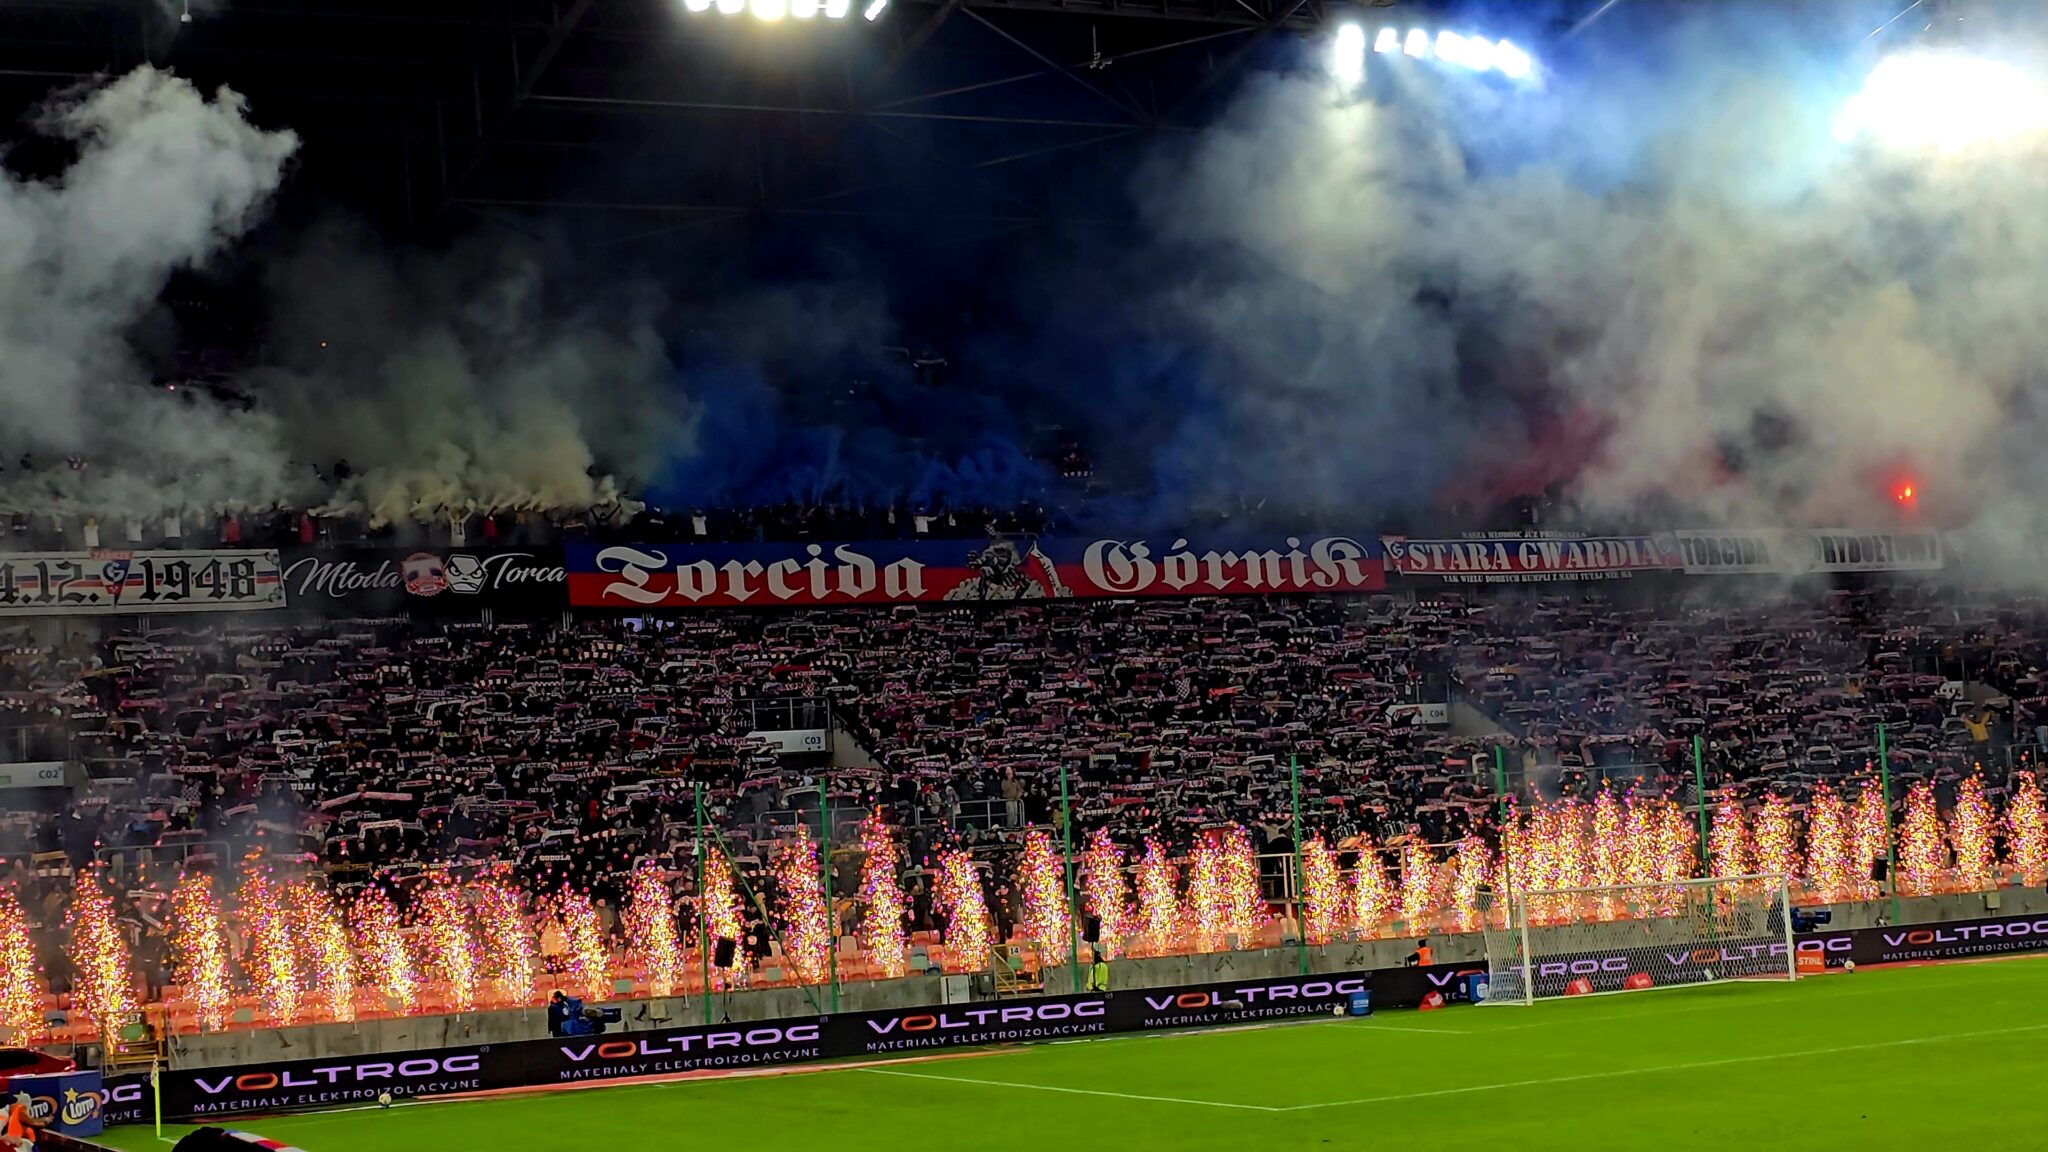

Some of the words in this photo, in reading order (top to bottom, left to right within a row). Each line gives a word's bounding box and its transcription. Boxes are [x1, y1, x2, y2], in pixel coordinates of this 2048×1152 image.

[1408, 542, 1512, 571] STARA
[1518, 539, 1662, 569] GWARDIA
[1680, 537, 1770, 566] TORCIDA
[139, 559, 256, 602] 1948
[283, 557, 402, 598] Młoda
[596, 544, 926, 604] Torcida
[1430, 709, 1444, 718] C04
[804, 736, 821, 745] C03
[38, 769, 59, 779] C02
[1797, 956, 1823, 966] STIHL
[1883, 948, 1940, 961] MATERIAŁY
[1144, 979, 1364, 1011] VOLTROG
[866, 1001, 1105, 1034] VOLTROG
[1144, 1012, 1218, 1028] MATERIAŁY
[560, 1025, 819, 1061] VOLTROG
[866, 1035, 947, 1052] MATERIAŁY
[953, 1022, 1105, 1044] ELEKTROIZOLACYJNE
[194, 1055, 480, 1094] VOLTROG
[560, 1063, 648, 1079] MATERIAŁY
[655, 1047, 820, 1071] ELEKTROIZOLACYJNE
[69, 1098, 94, 1119] LOTTO
[193, 1096, 289, 1113] MATERIAŁY
[299, 1079, 480, 1104] ELEKTROIZOLACYJNE
